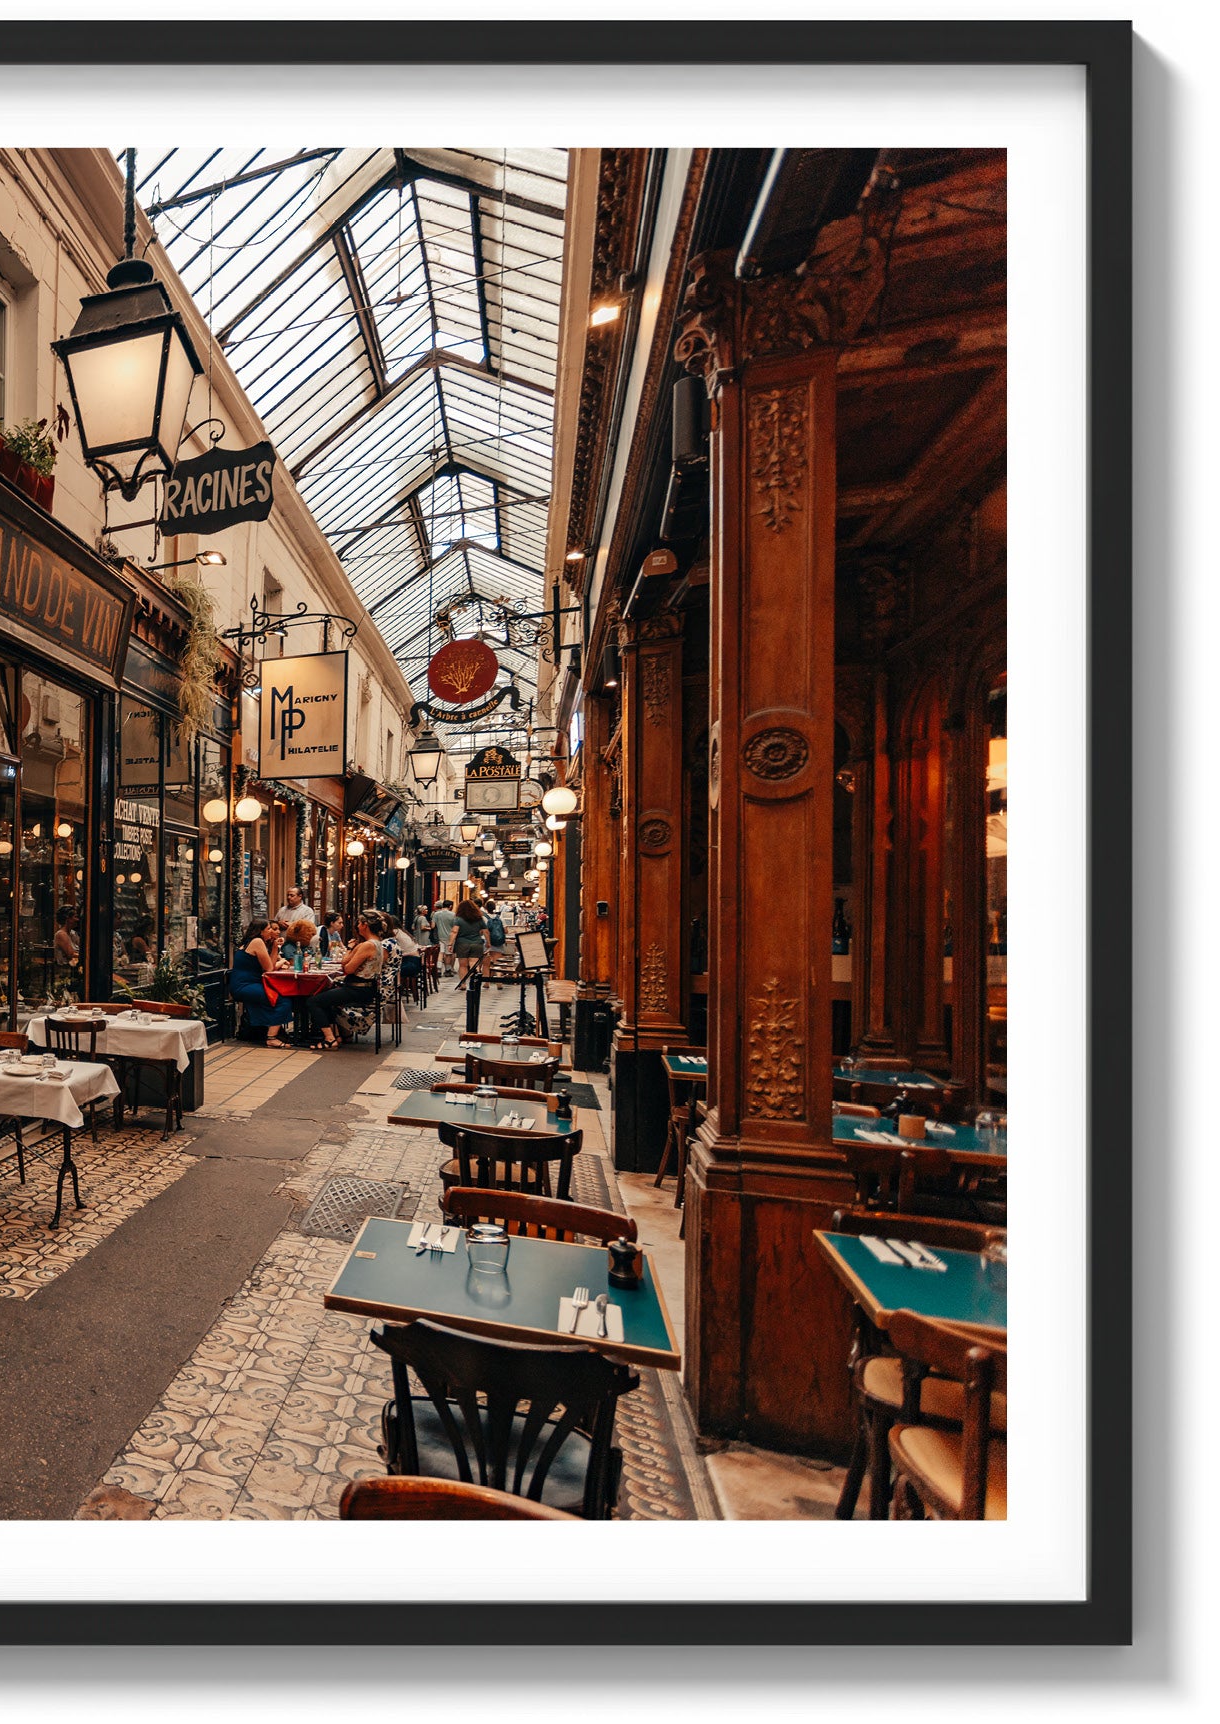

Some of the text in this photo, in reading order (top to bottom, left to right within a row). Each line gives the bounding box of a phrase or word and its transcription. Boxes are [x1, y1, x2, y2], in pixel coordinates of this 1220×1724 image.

[163, 461, 273, 521] RACINES
[44, 564, 78, 637] DE
[82, 590, 121, 661] VIN
[479, 766, 521, 777] POSTALE
[115, 798, 137, 822] ACHAT
[101, 858, 107, 873] 8
